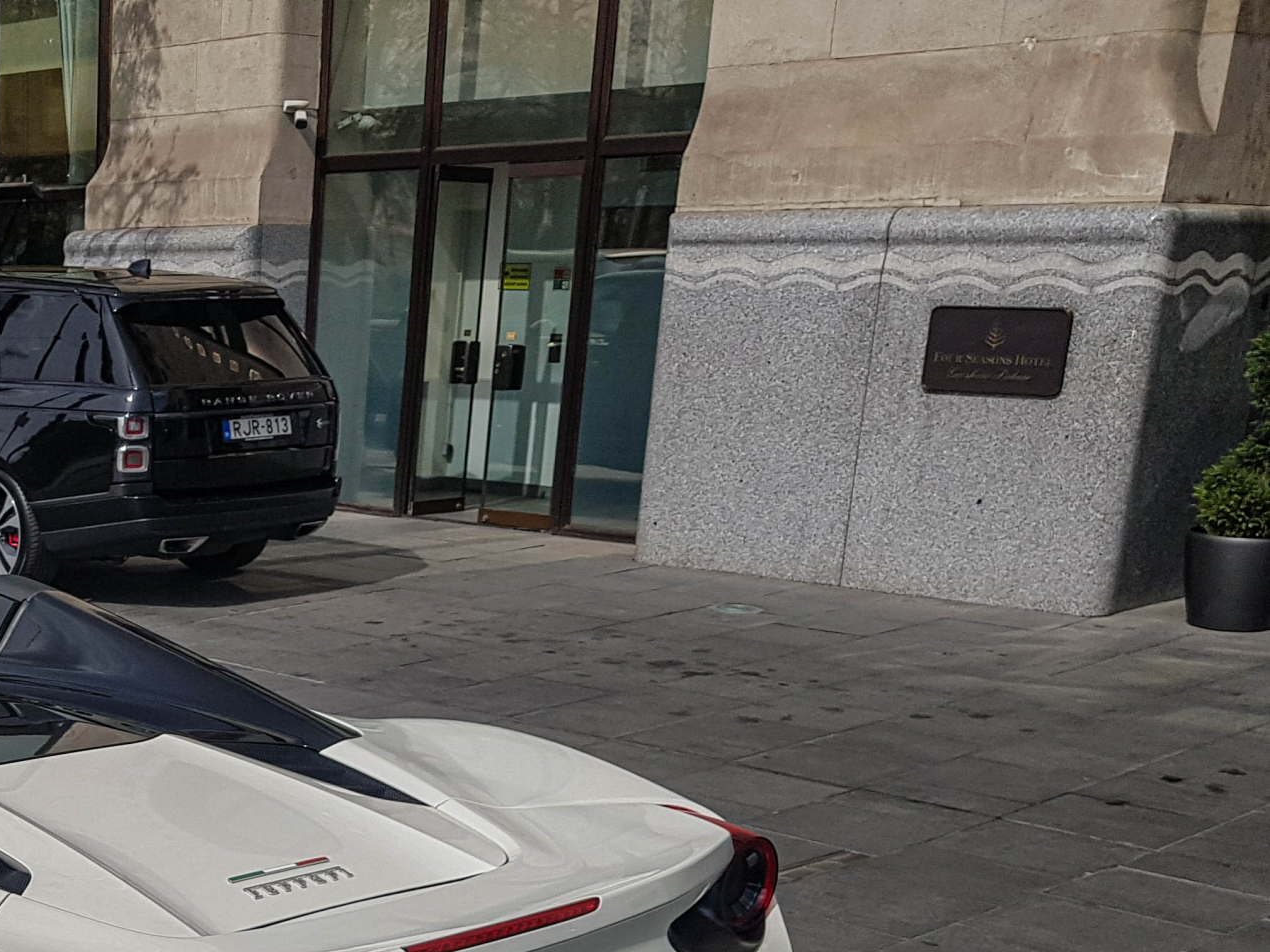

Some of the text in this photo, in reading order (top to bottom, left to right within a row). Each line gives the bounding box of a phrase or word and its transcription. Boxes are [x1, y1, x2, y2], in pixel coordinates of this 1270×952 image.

[933, 351, 1052, 367] FOUR SEASONS HOTEL
[232, 417, 289, 438] RJR-813
